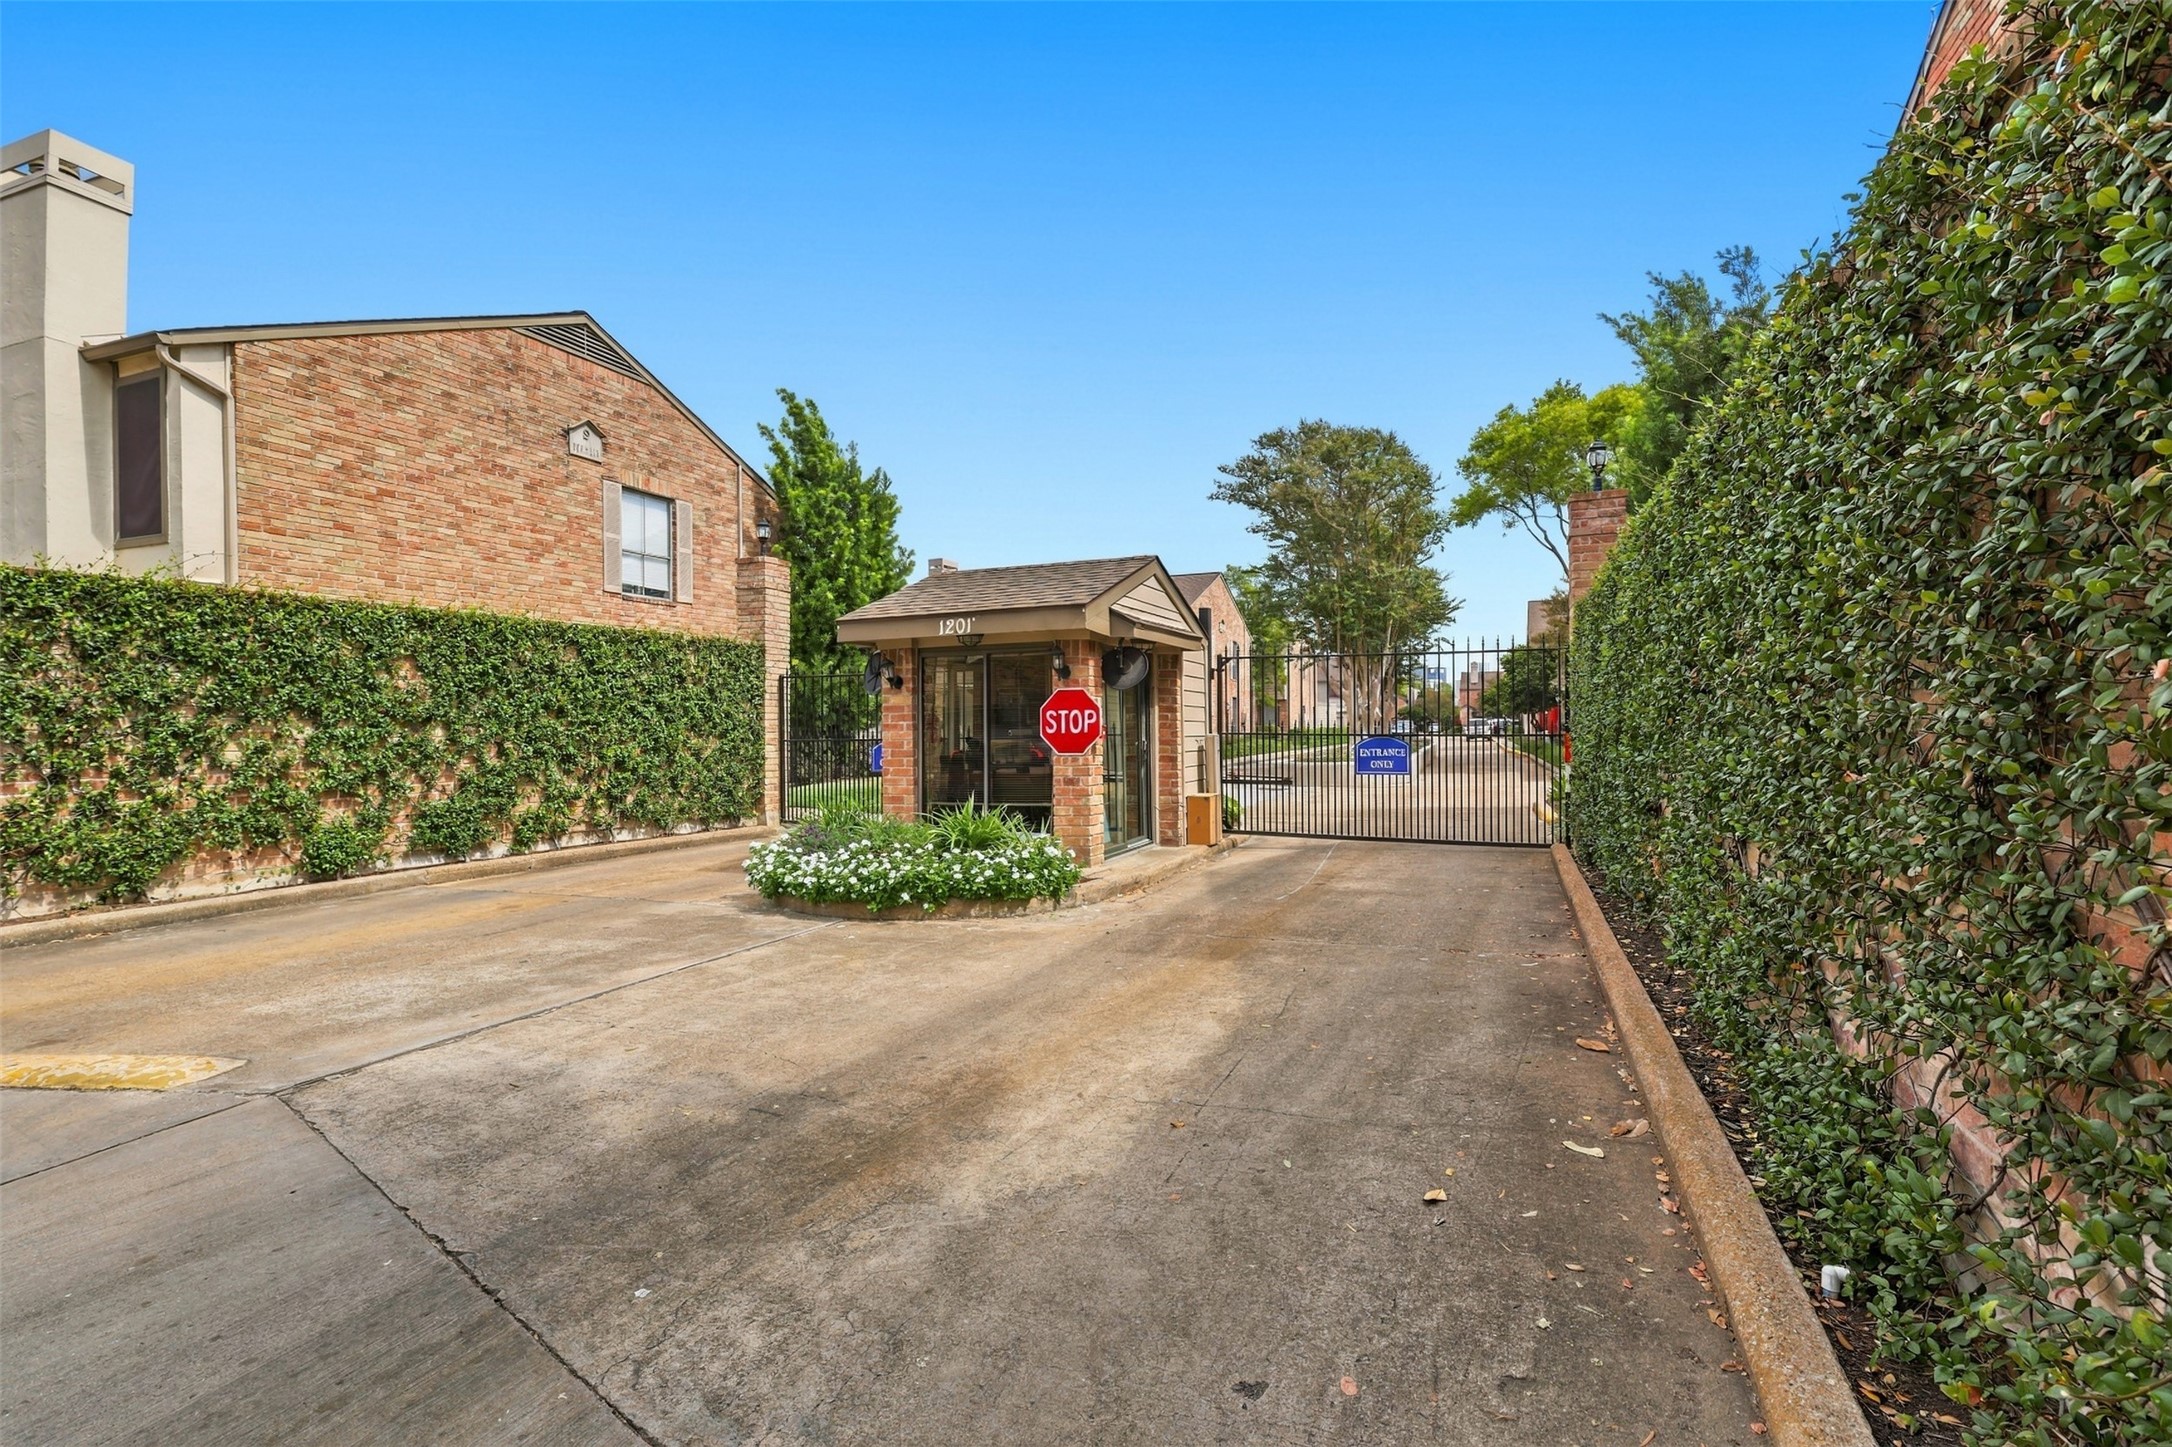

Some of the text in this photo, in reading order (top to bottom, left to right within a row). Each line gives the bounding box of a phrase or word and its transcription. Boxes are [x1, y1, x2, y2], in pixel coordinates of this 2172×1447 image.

[939, 617, 971, 636] 1201
[1045, 709, 1097, 734] STOP
[1360, 748, 1406, 757] ENTRANCE
[1370, 760, 1394, 769] ONLY
